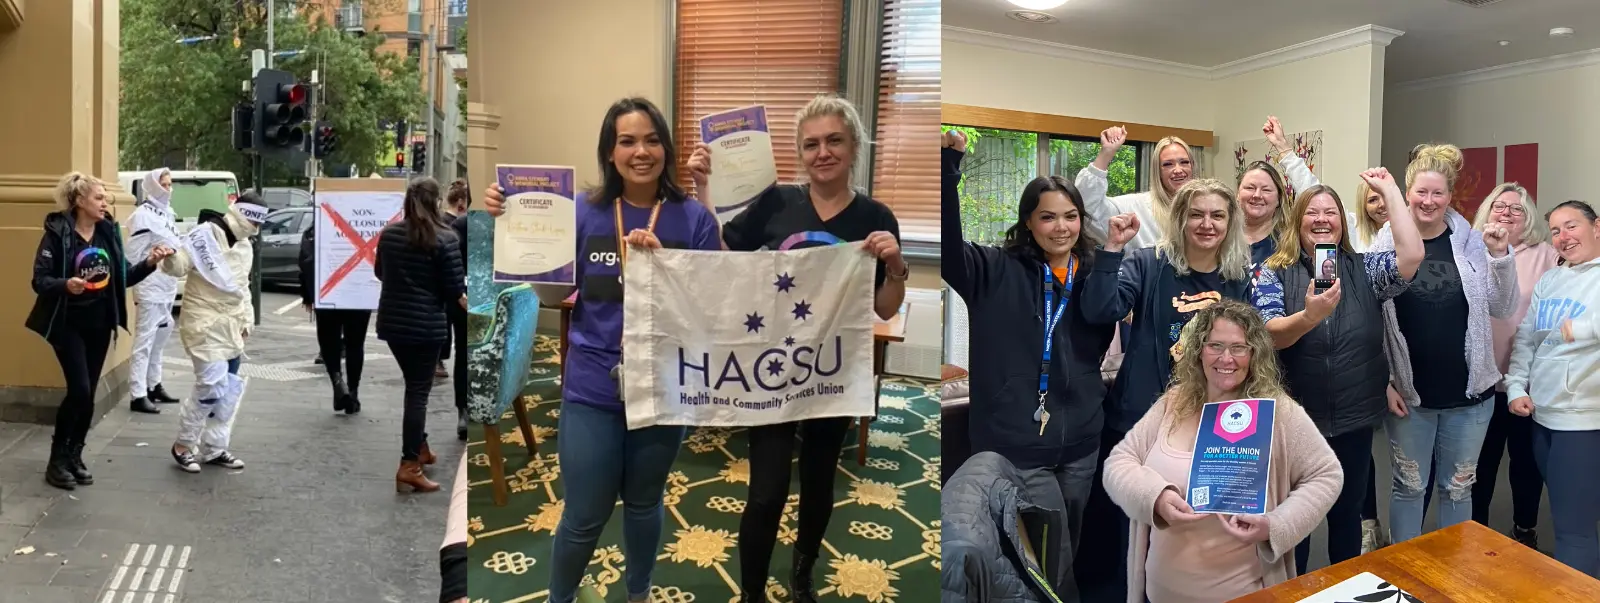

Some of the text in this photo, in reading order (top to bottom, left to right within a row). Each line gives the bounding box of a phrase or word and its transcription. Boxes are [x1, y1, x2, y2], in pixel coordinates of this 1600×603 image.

[519, 198, 552, 206] CERTIFICATE
[189, 230, 218, 271] WOMEN
[589, 252, 620, 266] org
[678, 336, 842, 392] HACSU
[680, 392, 711, 406] Health
[713, 396, 730, 406] and
[733, 396, 784, 411] Community
[817, 382, 844, 395] Union
[1203, 446, 1260, 456] JOIN THE UNION
